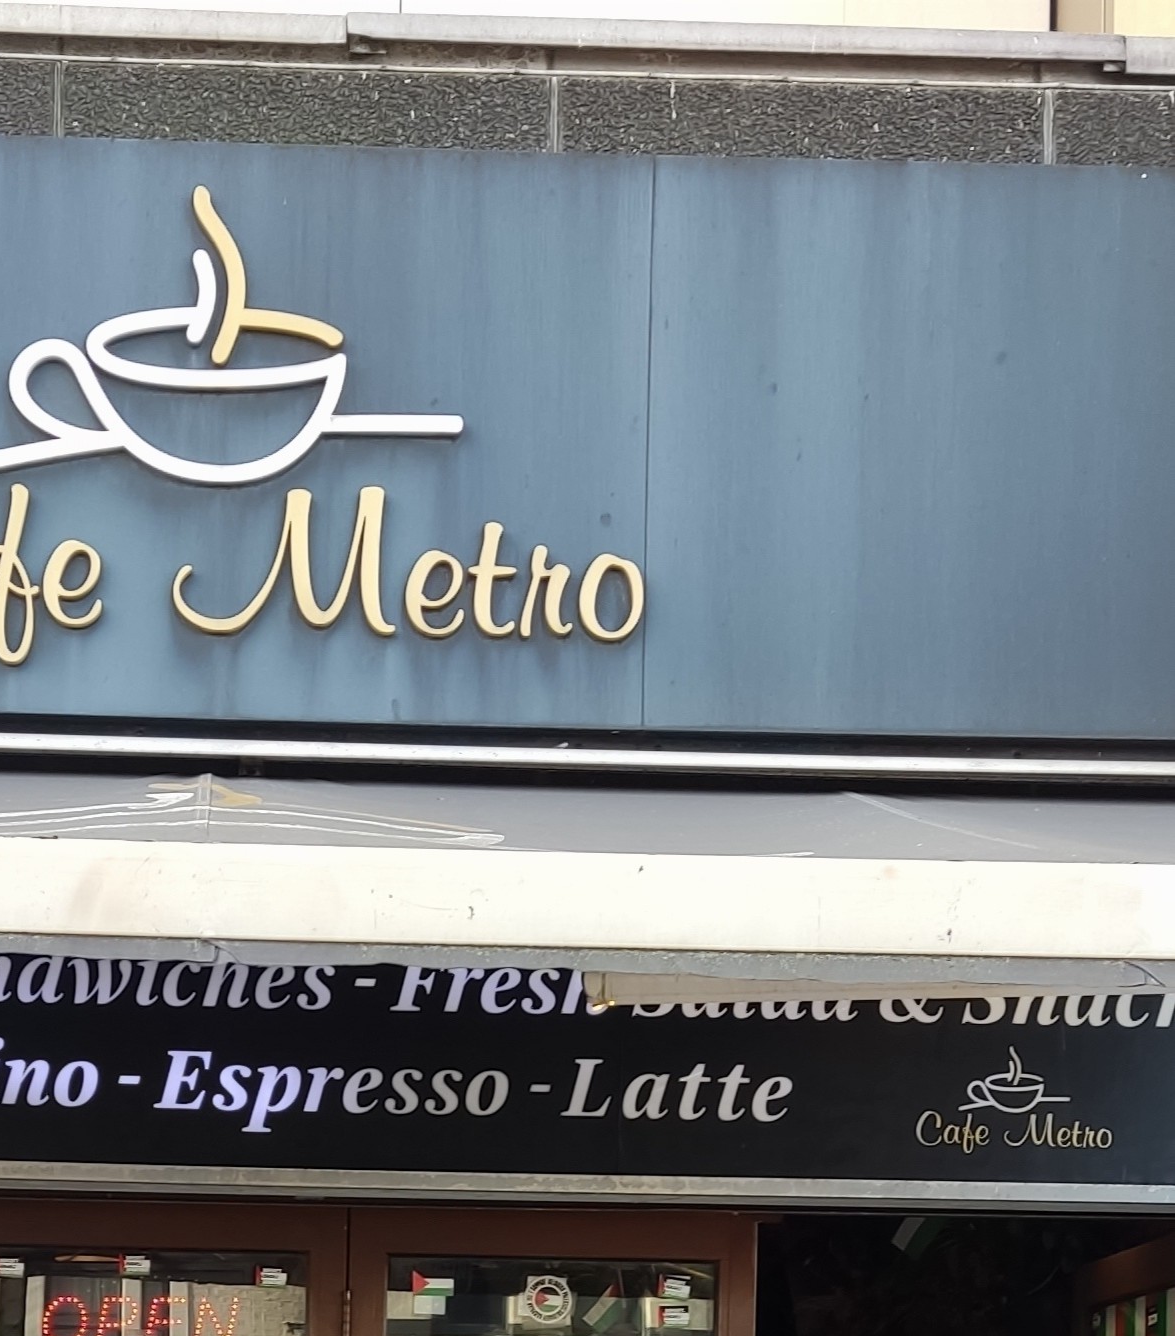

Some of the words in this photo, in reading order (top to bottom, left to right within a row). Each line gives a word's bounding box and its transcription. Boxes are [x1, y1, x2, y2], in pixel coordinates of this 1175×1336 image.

[173, 487, 645, 642] Metro
[153, 1050, 510, 1132] Espresso
[560, 1058, 794, 1122] Latte
[915, 1110, 990, 1154] Cafe
[1004, 1113, 1113, 1149] Metro
